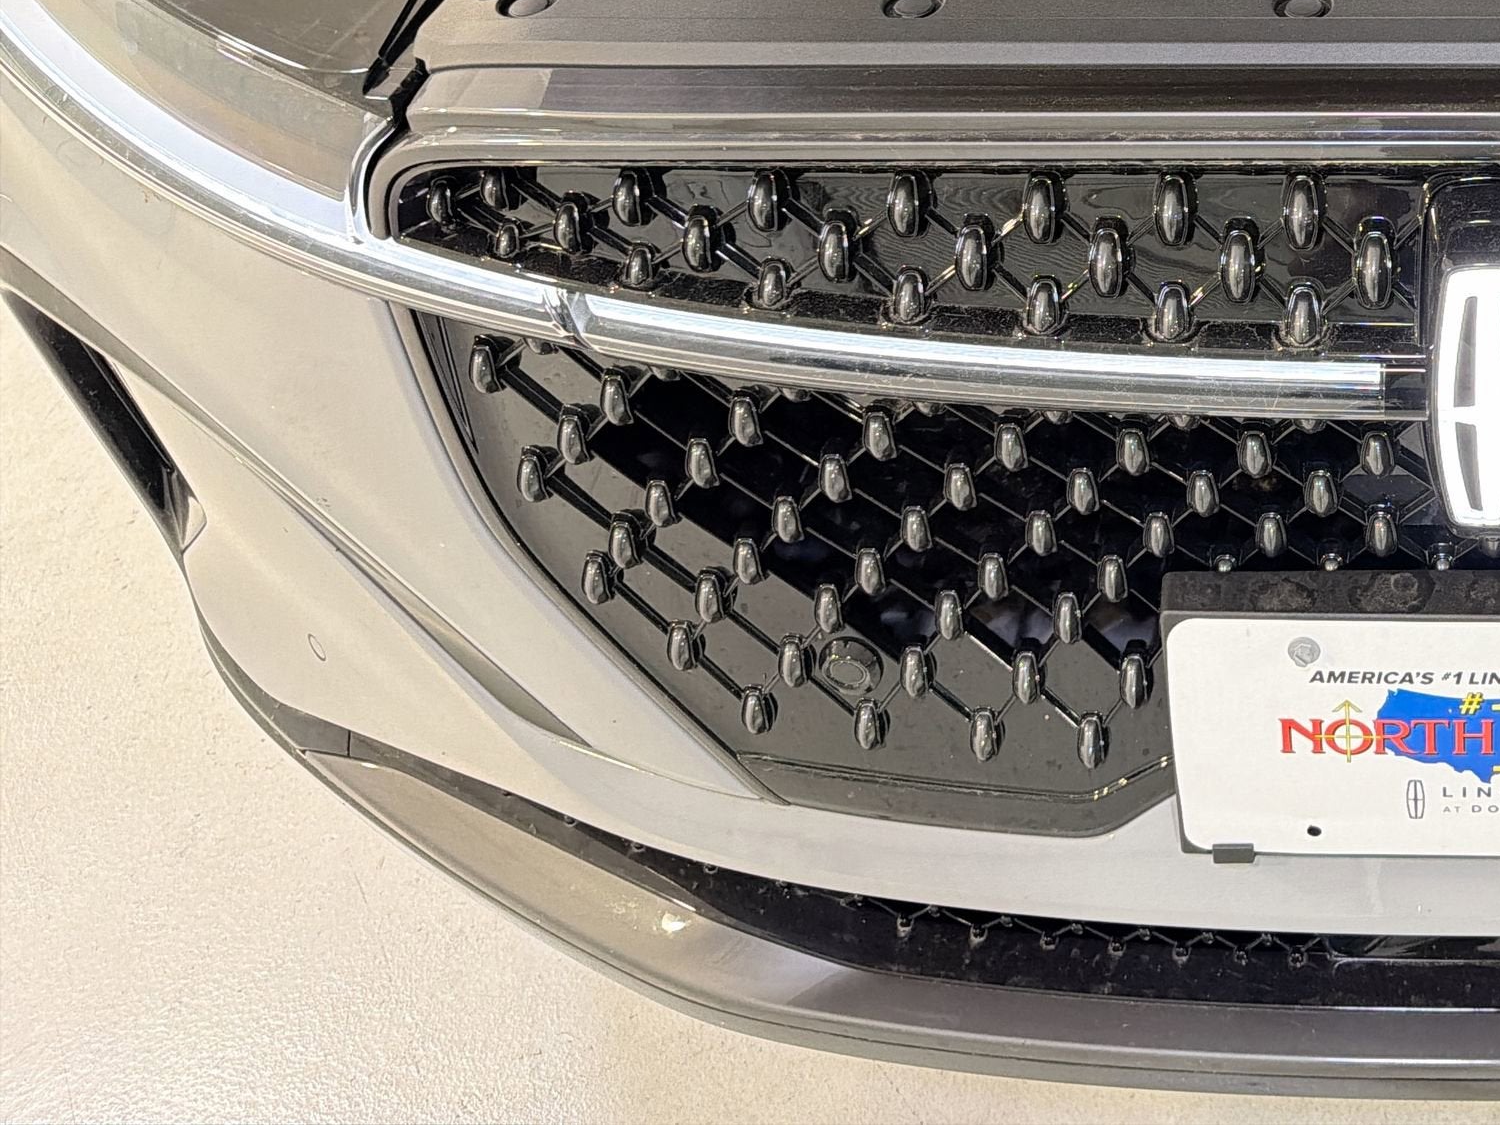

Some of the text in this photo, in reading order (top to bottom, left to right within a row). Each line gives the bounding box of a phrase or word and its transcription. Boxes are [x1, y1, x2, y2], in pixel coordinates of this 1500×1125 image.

[1309, 671, 1434, 685] AMERICA'S
[1441, 671, 1463, 685] #1
[1279, 717, 1495, 755] NORTH
[1443, 805, 1462, 814] AT
